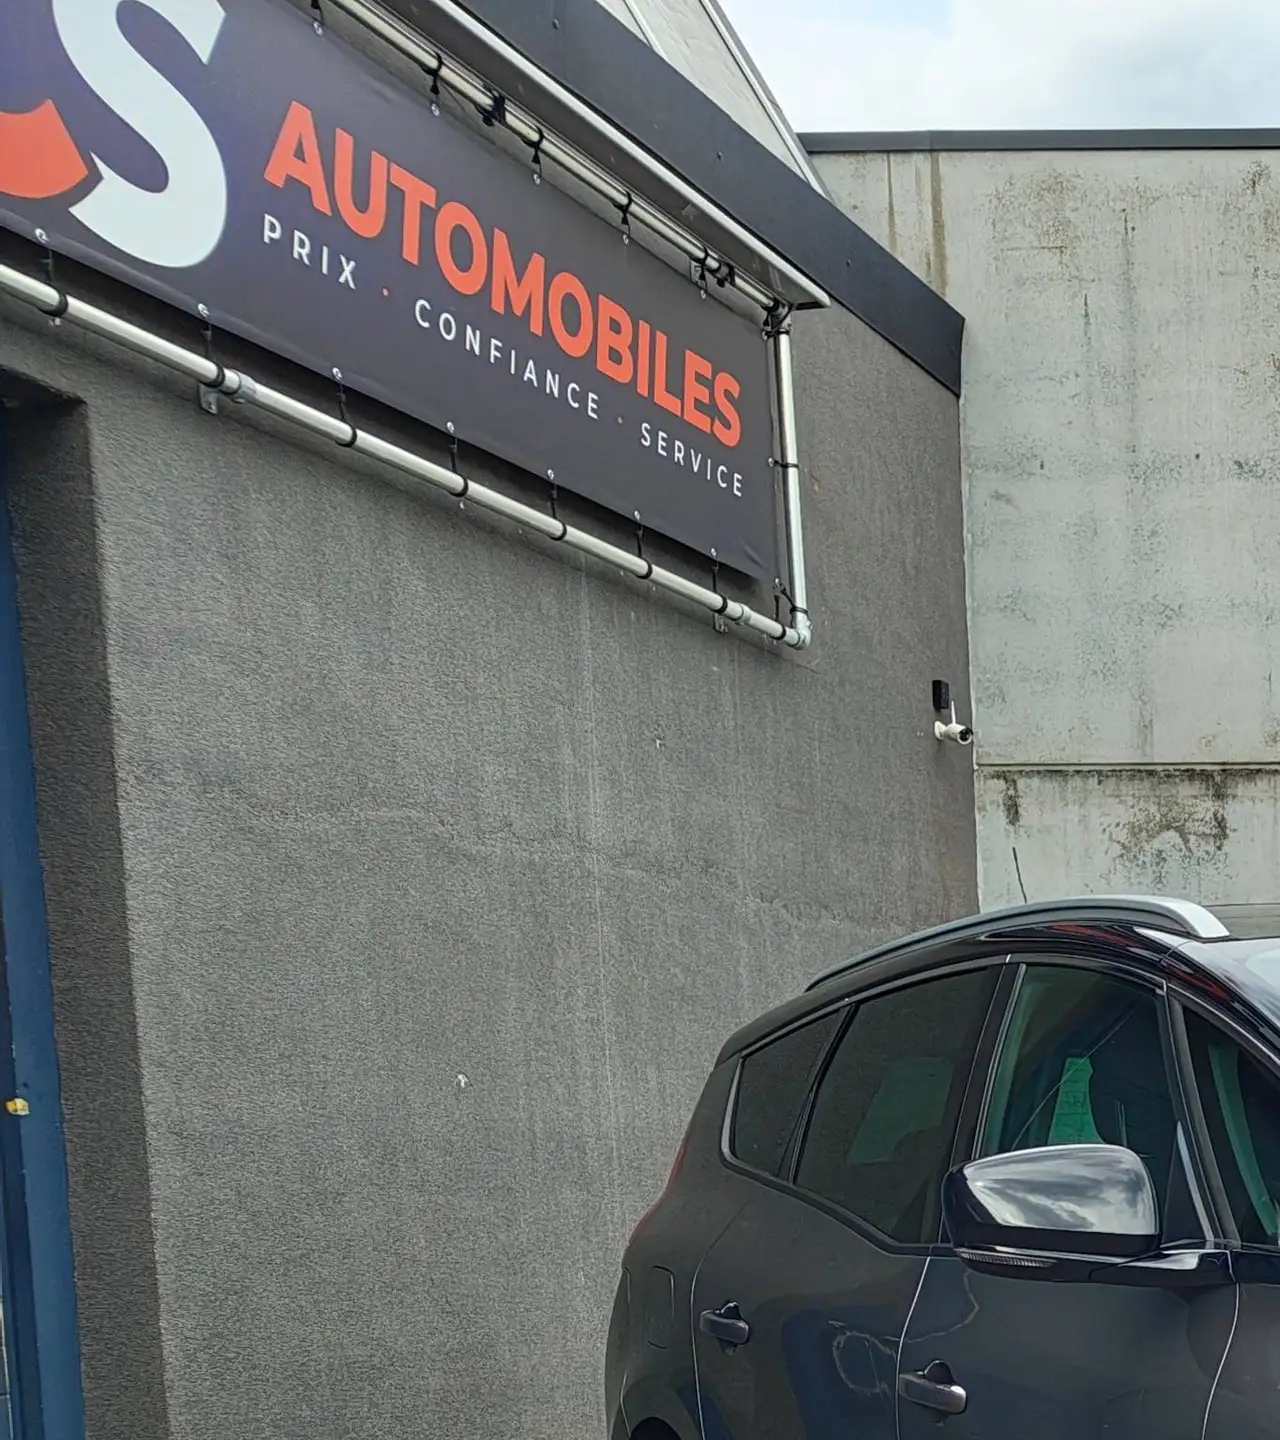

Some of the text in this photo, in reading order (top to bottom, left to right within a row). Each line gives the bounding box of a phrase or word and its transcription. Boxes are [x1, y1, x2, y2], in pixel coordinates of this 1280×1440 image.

[262, 213, 744, 498] PRIX CONFIANCE SERVICE
[264, 100, 743, 448] AUTOMOBILES
